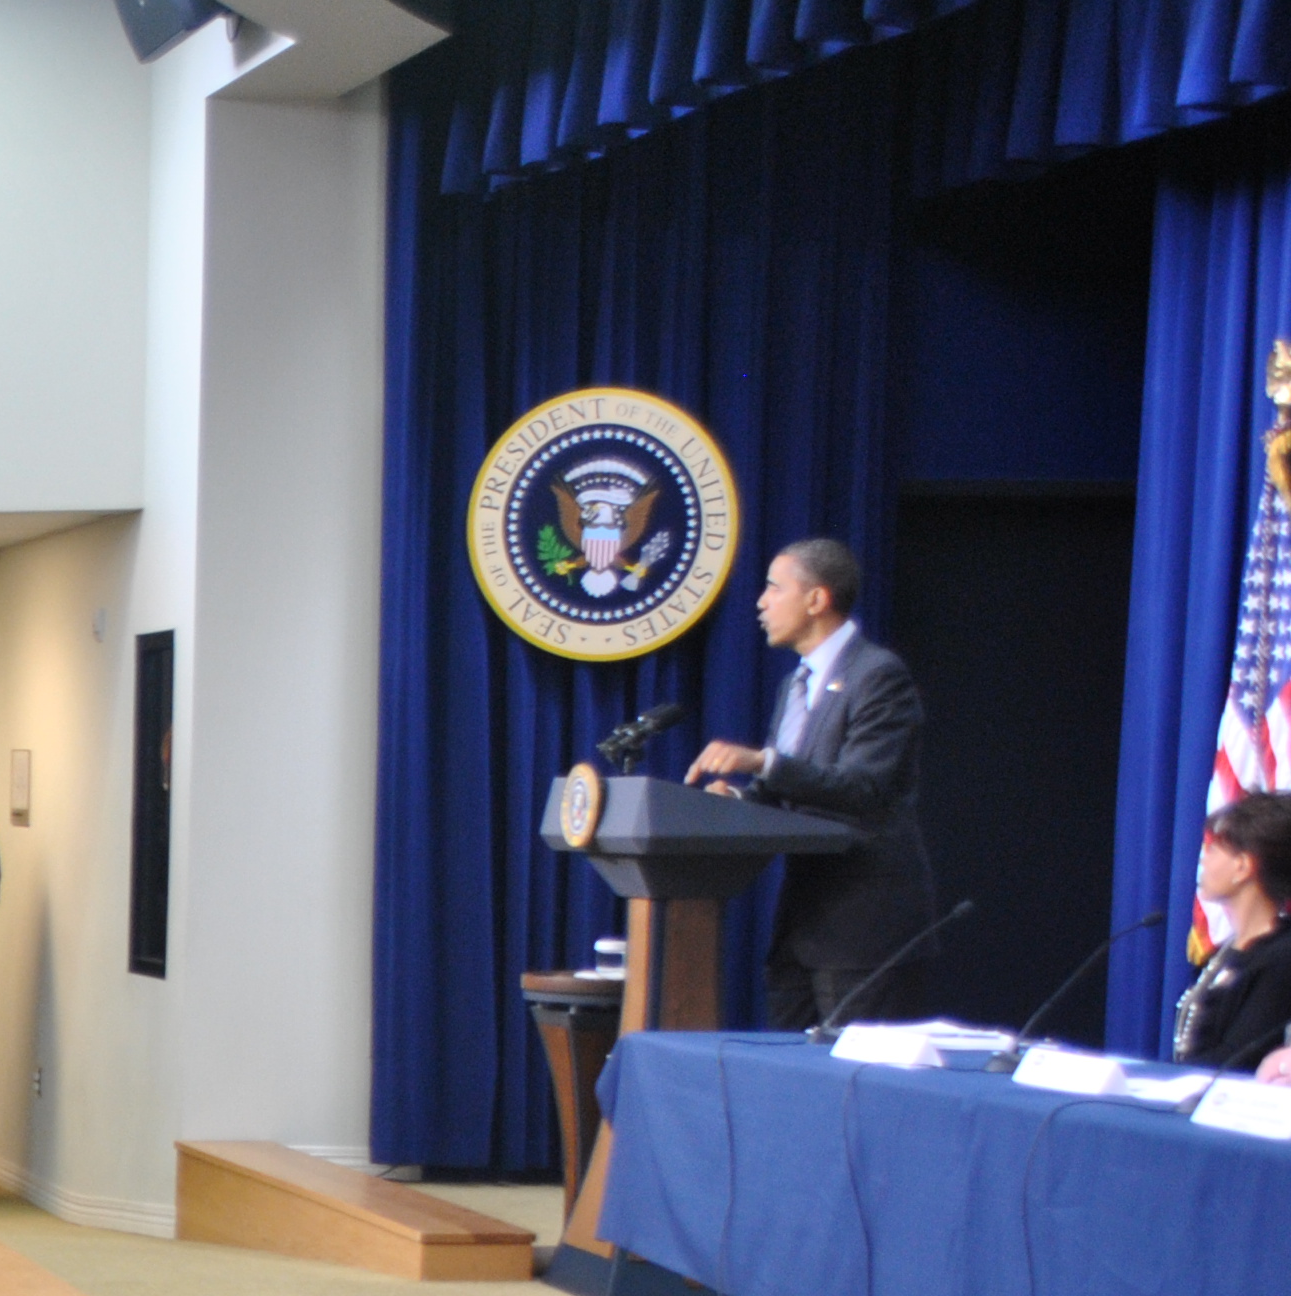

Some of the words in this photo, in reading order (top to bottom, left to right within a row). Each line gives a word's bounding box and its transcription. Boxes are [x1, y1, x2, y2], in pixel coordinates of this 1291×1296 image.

[616, 403, 641, 418] OF
[646, 412, 677, 439] THE
[480, 398, 606, 511] PRESIDENT
[681, 438, 726, 551] UNITED
[482, 522, 496, 557] THE
[489, 565, 508, 587] OF
[508, 588, 571, 645] SEAL
[622, 567, 713, 646] STATES
